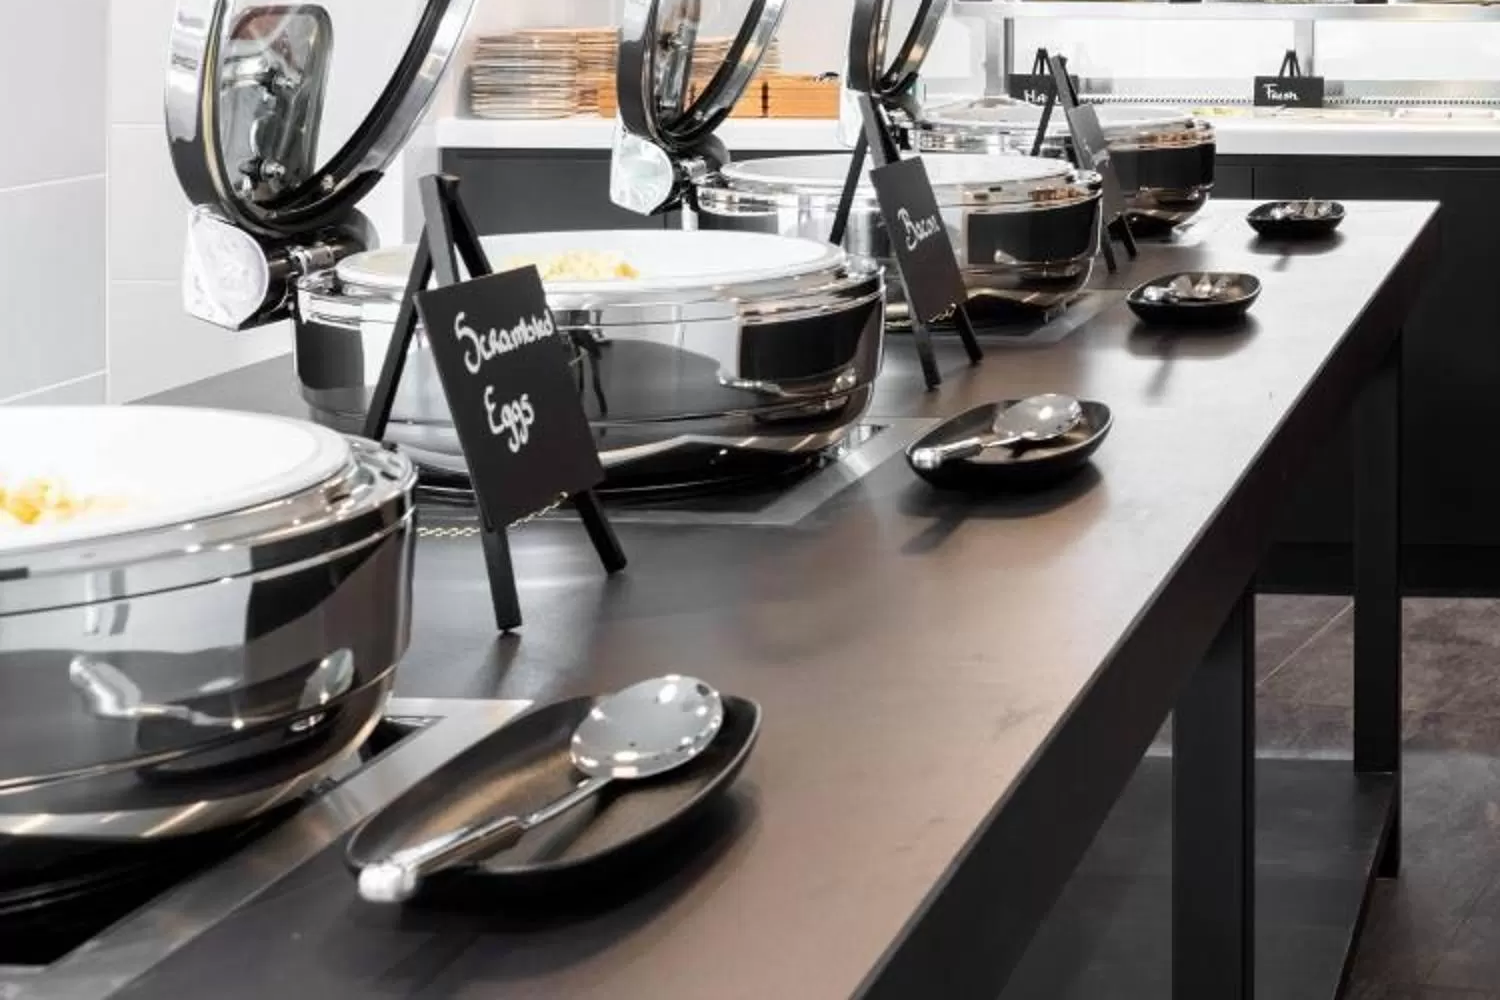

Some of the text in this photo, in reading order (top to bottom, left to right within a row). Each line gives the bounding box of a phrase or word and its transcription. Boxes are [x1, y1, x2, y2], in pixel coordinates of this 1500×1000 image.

[897, 207, 941, 251] Bacon
[454, 308, 553, 374] Scrambled
[483, 385, 535, 453] Eggs
